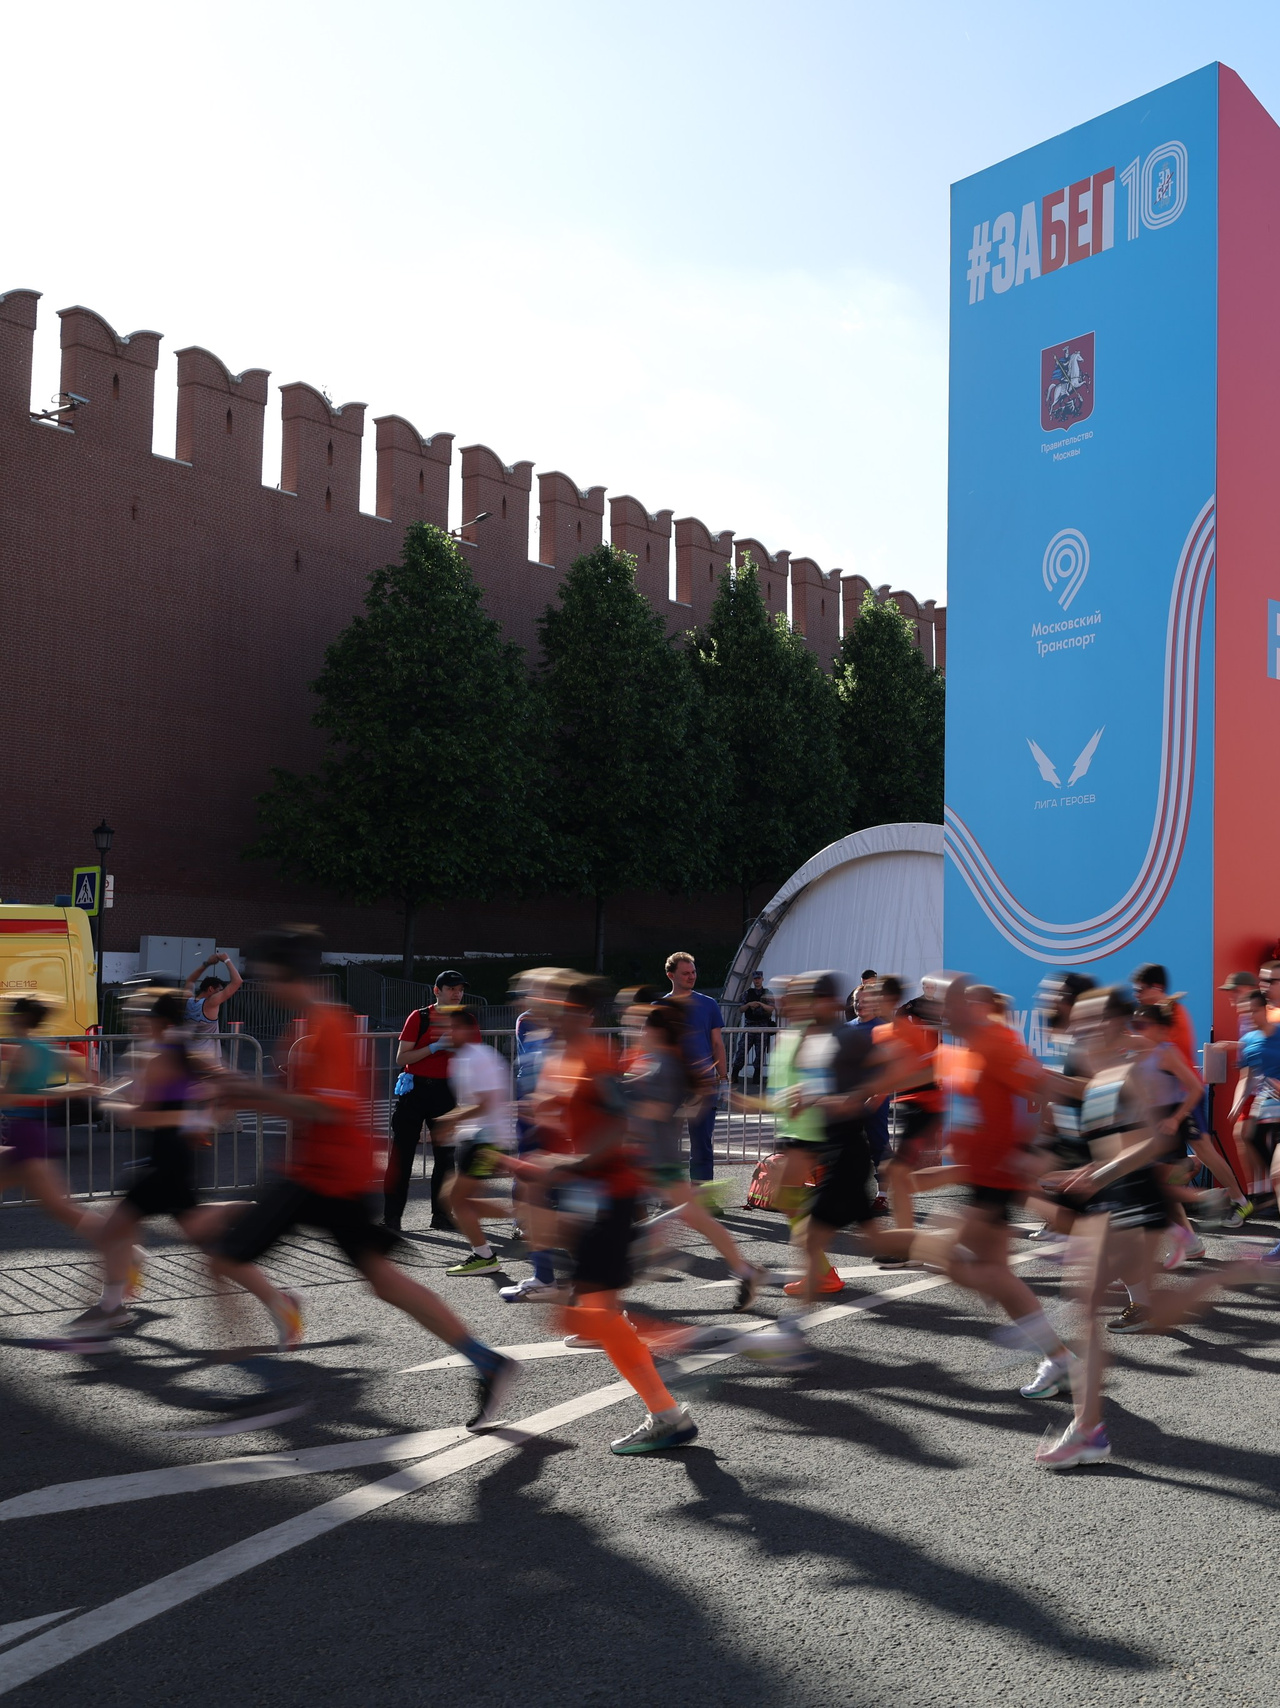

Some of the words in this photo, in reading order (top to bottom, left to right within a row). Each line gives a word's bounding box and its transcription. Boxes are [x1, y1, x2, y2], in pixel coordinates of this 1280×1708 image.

[966, 166, 1116, 305] #ЗАБЕГ
[1119, 139, 1188, 241] 10
[1041, 430, 1094, 454] Правительство
[1053, 448, 1081, 462] Москвы
[1031, 609, 1102, 638] Московский
[1036, 633, 1096, 658] Транспорт
[1034, 799, 1057, 810] ЛИГА
[1060, 794, 1096, 806] ГЕРОЕВ
